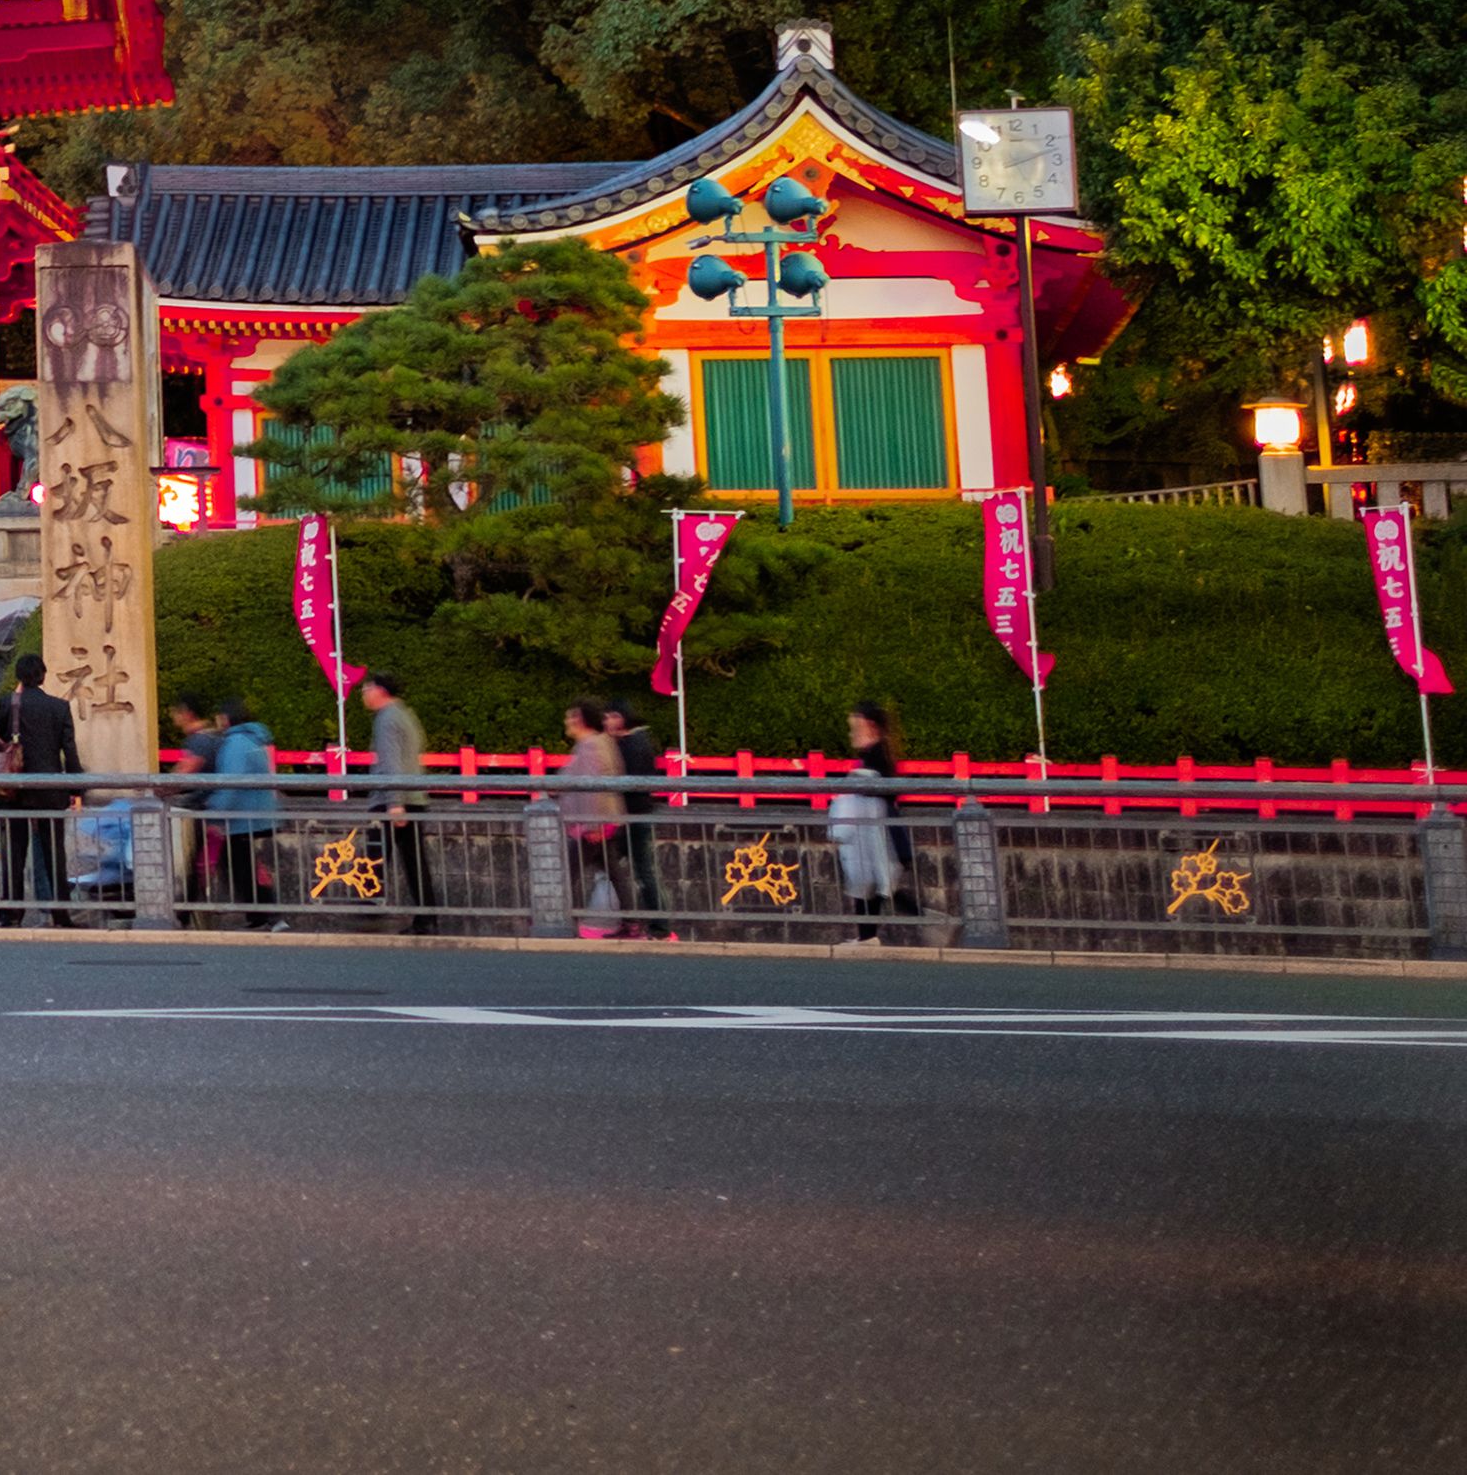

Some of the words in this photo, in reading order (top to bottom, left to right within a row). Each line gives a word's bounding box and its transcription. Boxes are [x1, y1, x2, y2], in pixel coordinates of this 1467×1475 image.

[1008, 119, 1022, 132] 12
[1045, 134, 1055, 147] 2
[972, 157, 982, 169] 9
[1052, 154, 1063, 166] 3
[979, 175, 989, 188] 8
[1047, 173, 1058, 184] 4
[997, 187, 1006, 200] 7
[1014, 191, 1025, 204] 6
[1034, 185, 1044, 198] 5
[44, 404, 134, 722] 八坂神社
[994, 527, 1024, 656] 祝七五三
